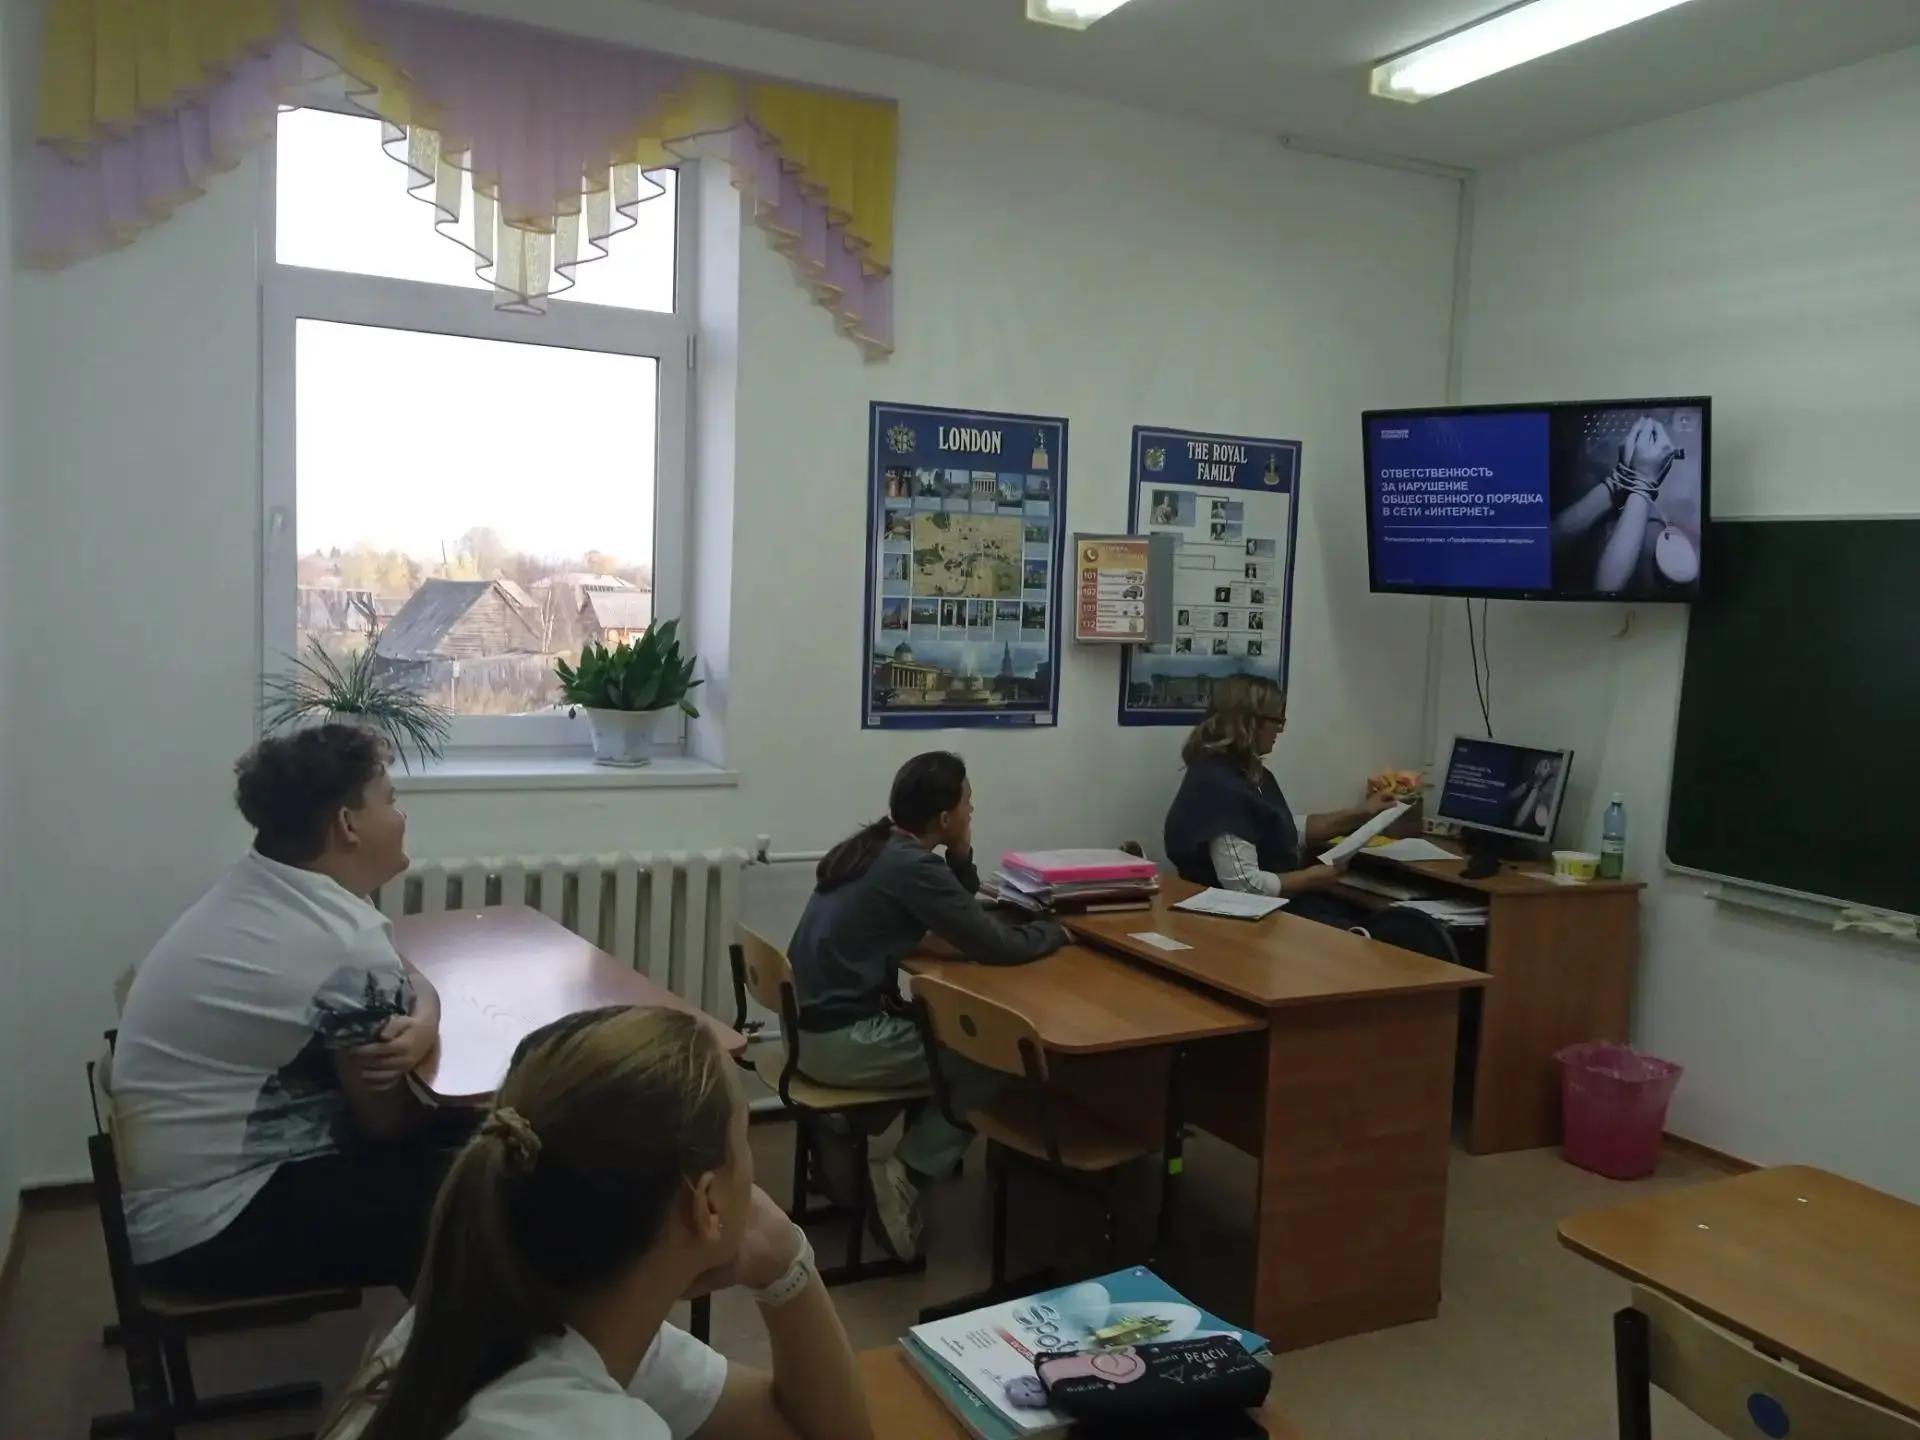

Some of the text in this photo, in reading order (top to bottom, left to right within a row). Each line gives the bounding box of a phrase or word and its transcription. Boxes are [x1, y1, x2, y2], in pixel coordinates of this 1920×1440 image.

[938, 426, 1002, 455] LONDON
[1187, 441, 1248, 464] THE ROYAL
[1197, 462, 1236, 482] FAMILY
[1381, 467, 1494, 479] ОТВЕТСТВЕННОСТЬ
[1381, 481, 1469, 492] ЗА НАРУШЕНИЕ
[1382, 493, 1544, 505] ОБЩЕСТВЕННОГО ПОРЯДКА
[1383, 506, 1495, 517] В СЕТИ «ИНТЕРНЕТ»
[1083, 571, 1097, 579] 101
[1082, 587, 1097, 595] 102
[1082, 620, 1096, 628] 112
[1184, 1347, 1228, 1364] PEACH
